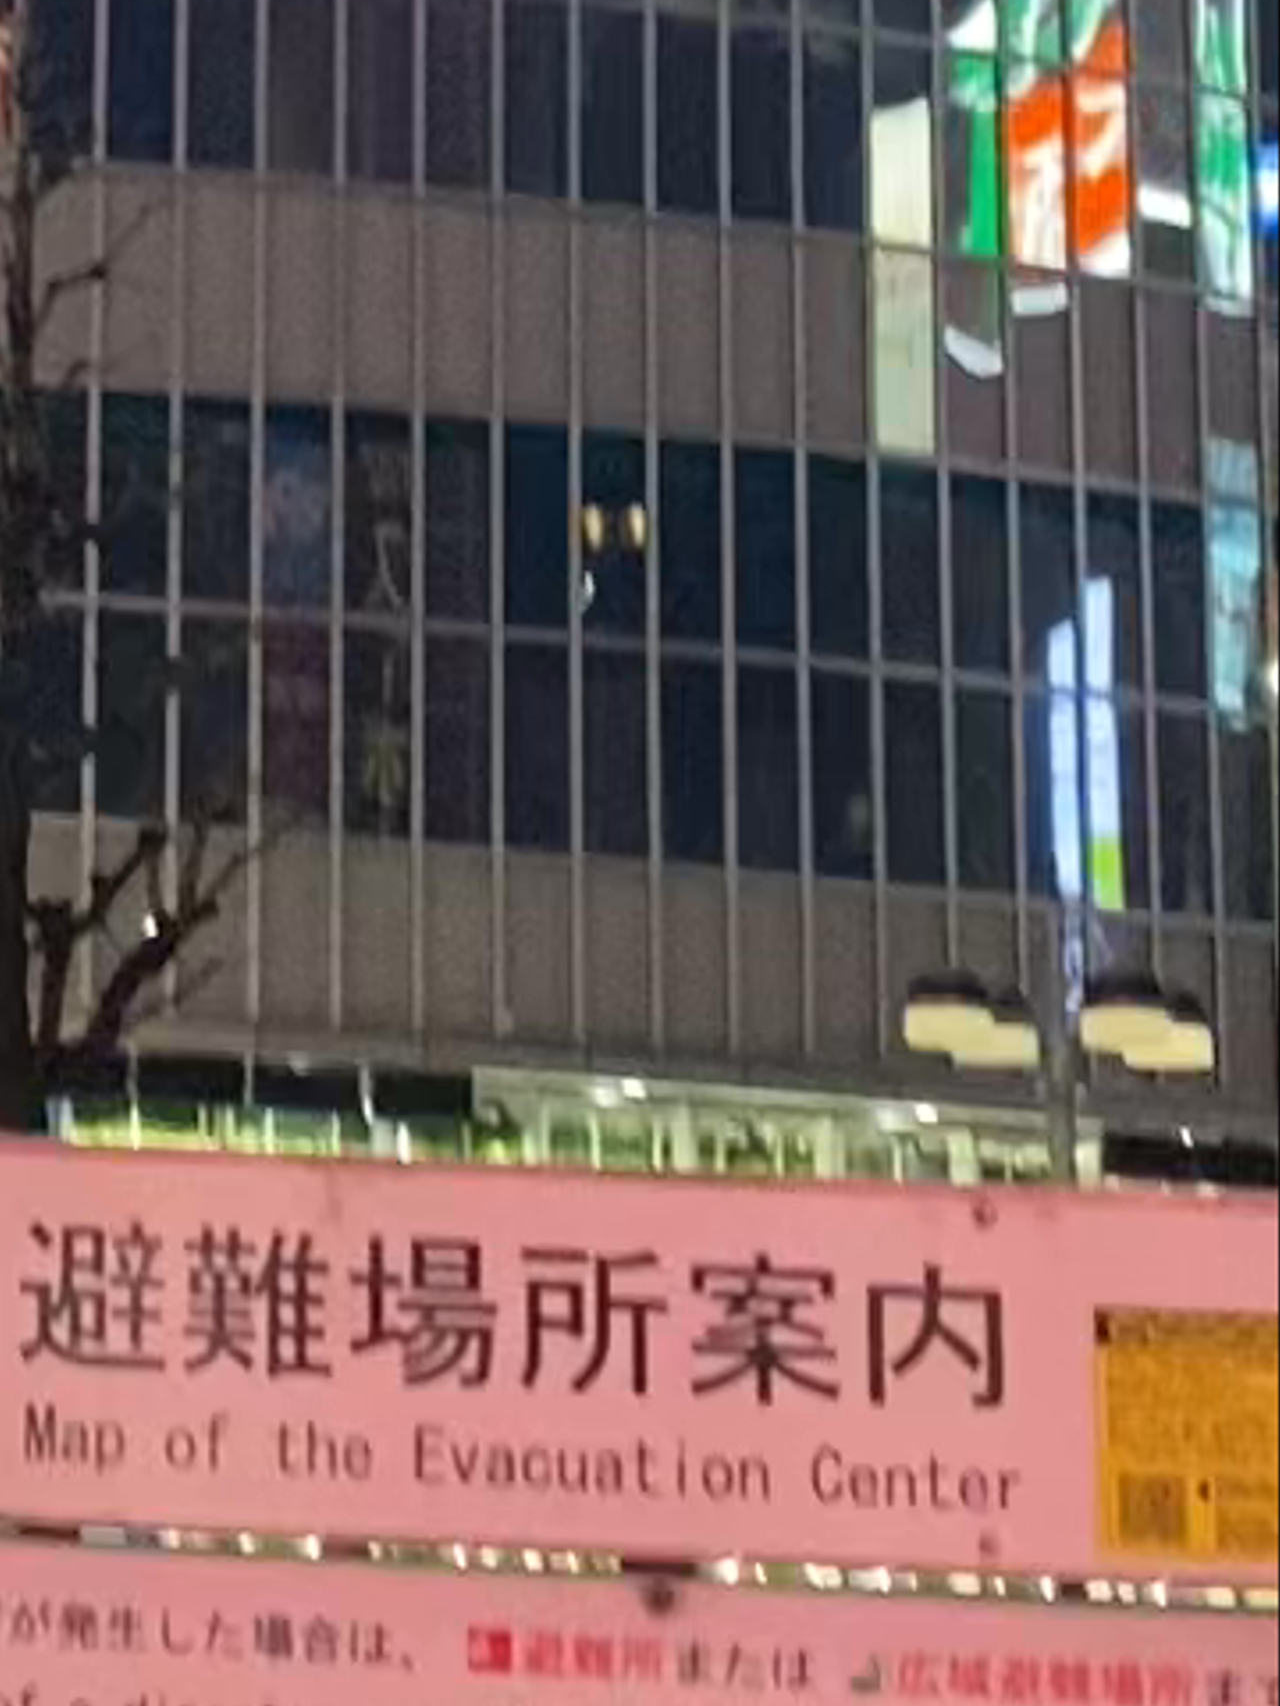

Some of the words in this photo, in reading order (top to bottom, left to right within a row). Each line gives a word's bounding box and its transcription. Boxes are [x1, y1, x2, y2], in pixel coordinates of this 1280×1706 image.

[18, 1218, 1007, 1409] 避難場所案内
[22, 1402, 127, 1470] Map
[163, 1412, 230, 1470] of
[276, 1422, 375, 1484] the
[413, 1422, 774, 1503] Evacuation
[810, 1442, 1021, 1513] Center
